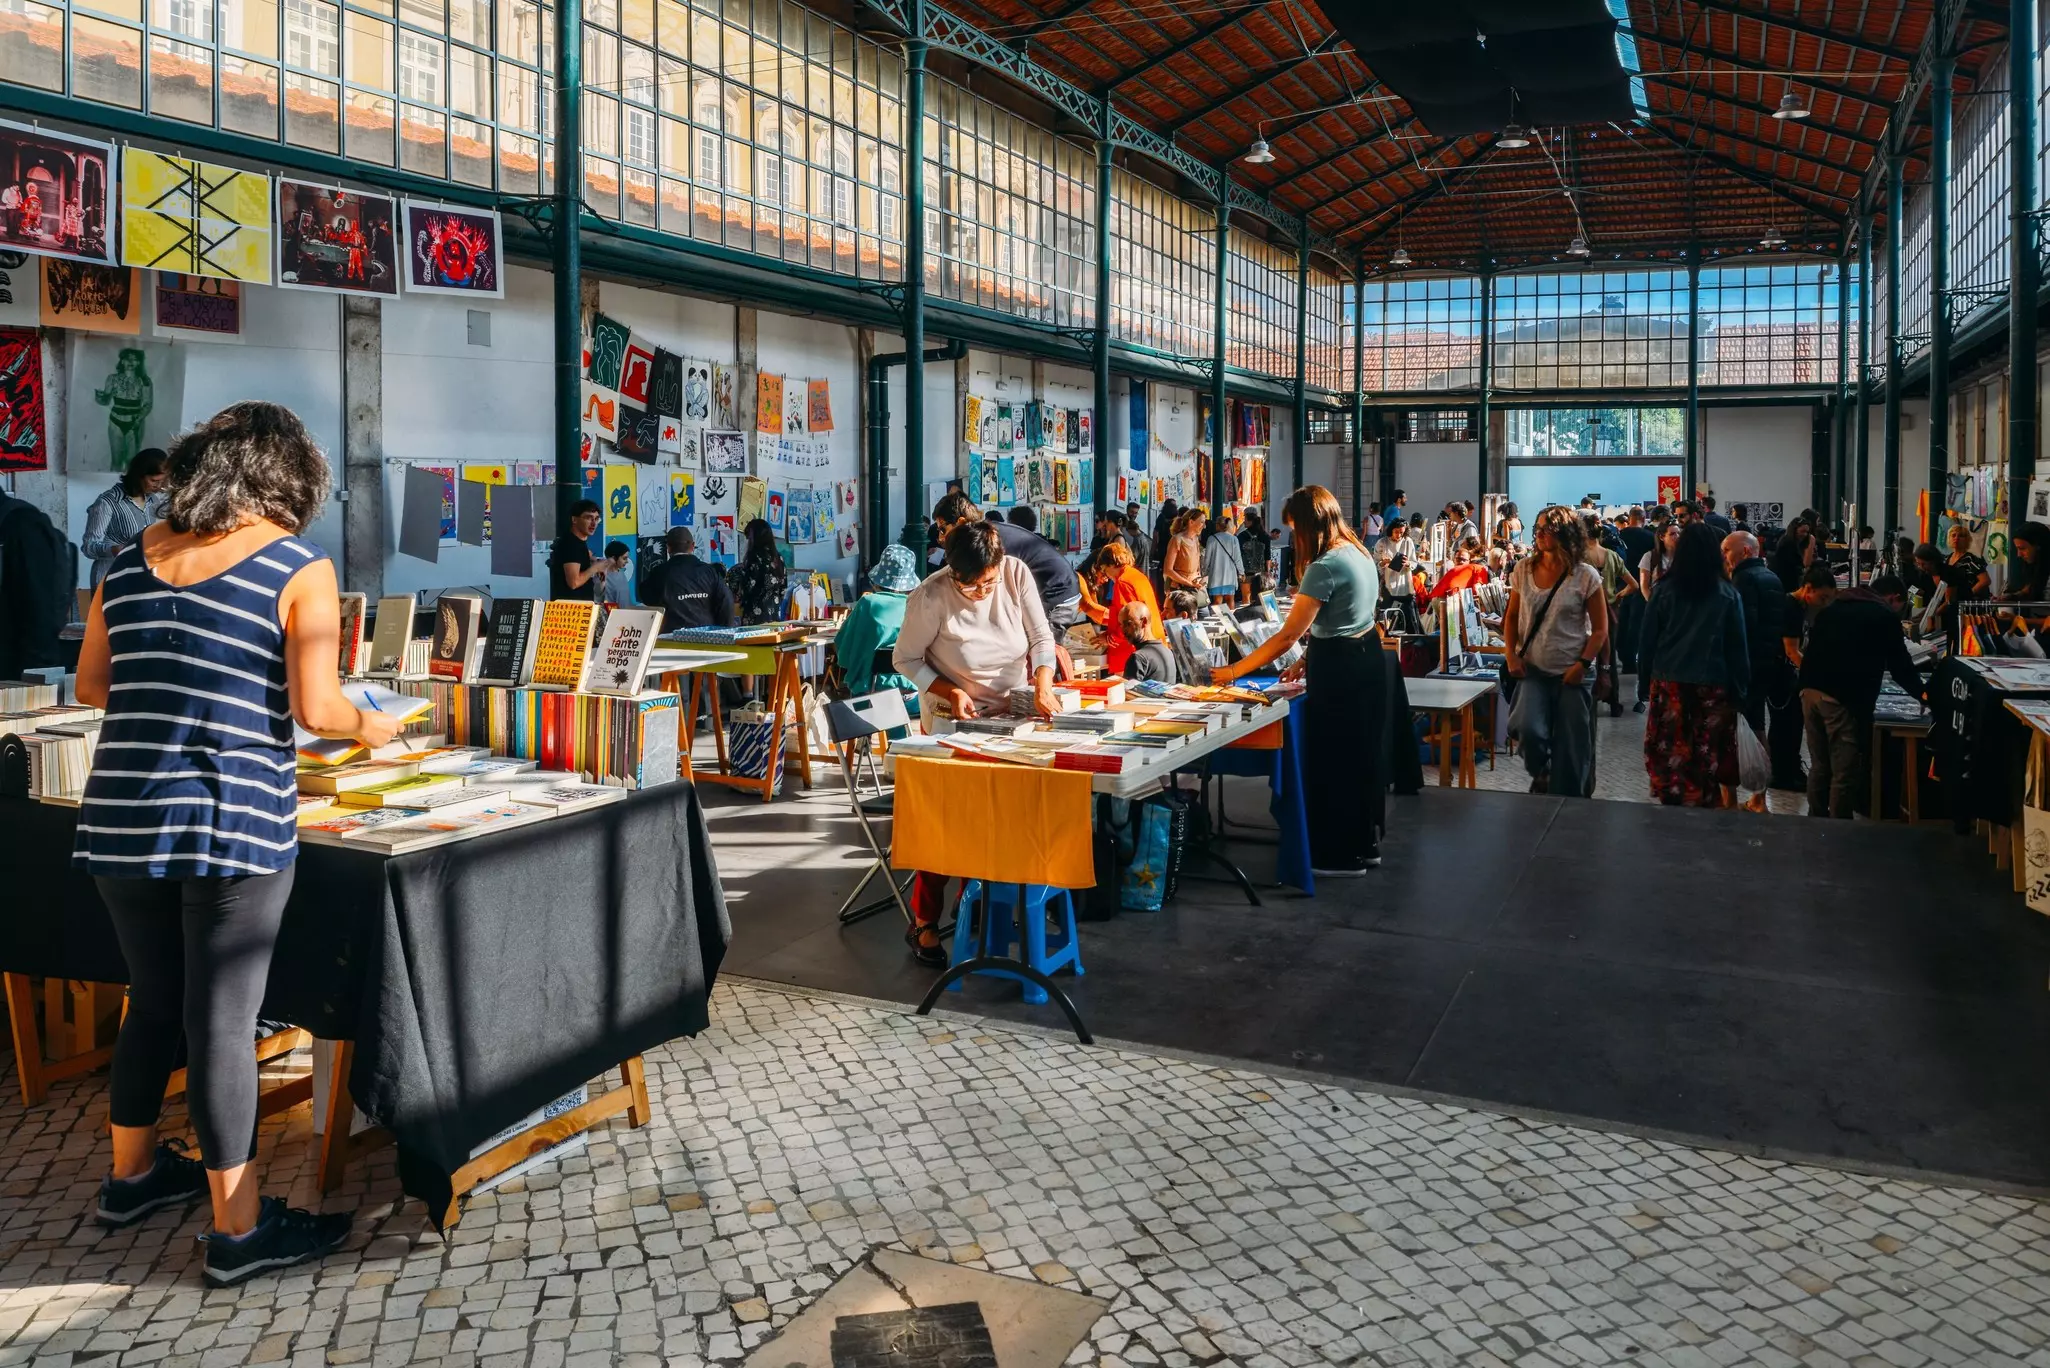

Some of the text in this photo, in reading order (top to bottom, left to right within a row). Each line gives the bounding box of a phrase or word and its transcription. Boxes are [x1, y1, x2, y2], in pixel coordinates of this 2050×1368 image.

[184, 315, 229, 330] LONGE
[677, 592, 709, 601] UMBRO
[619, 626, 642, 639] john
[611, 637, 640, 650] fante
[607, 648, 640, 659] pergunta
[616, 656, 629, 668] pó
